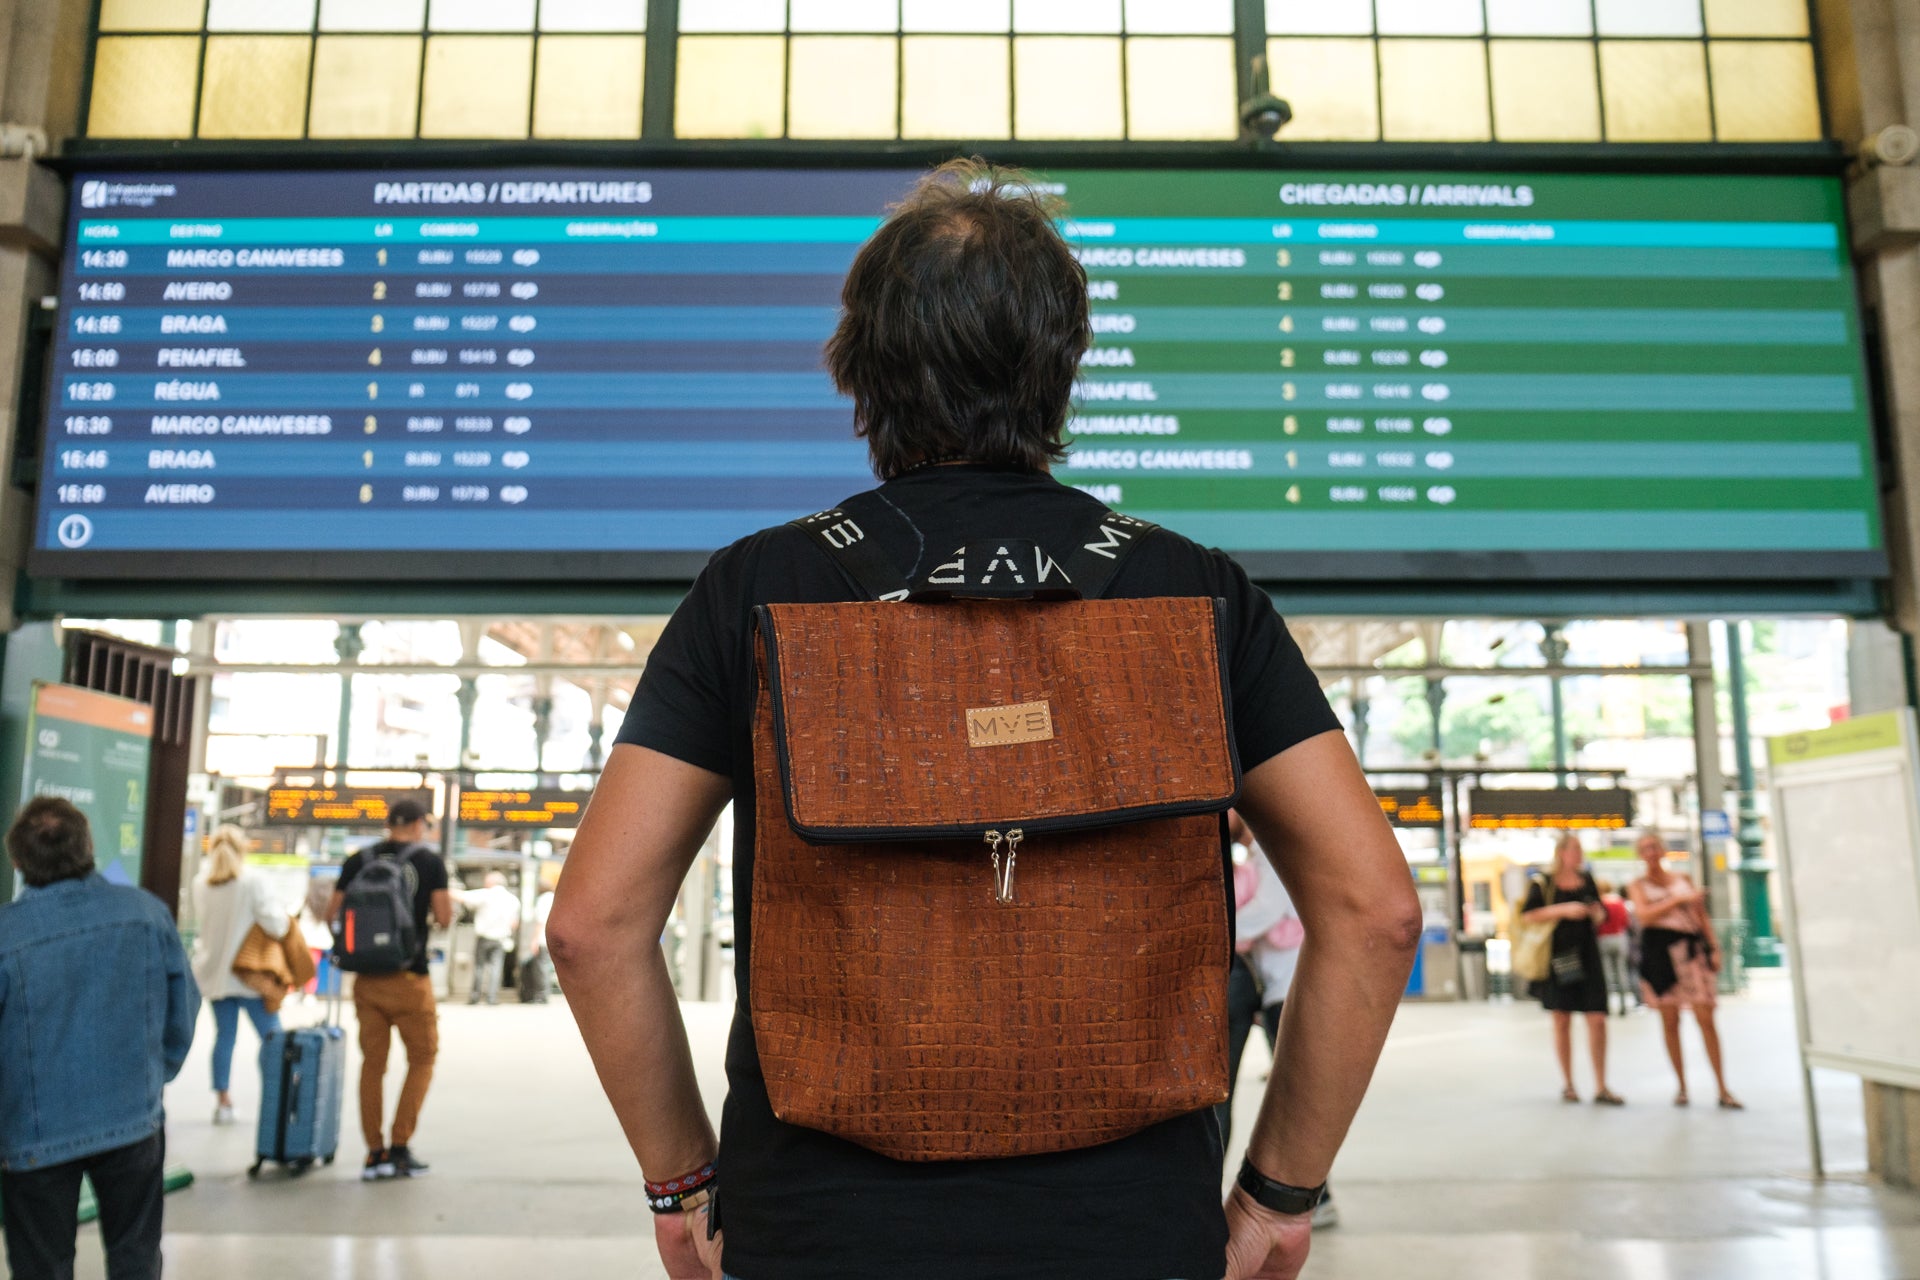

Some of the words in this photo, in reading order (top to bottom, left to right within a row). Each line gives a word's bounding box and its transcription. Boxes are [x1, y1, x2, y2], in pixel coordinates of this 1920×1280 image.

[374, 183, 485, 203] PARTIDAS
[488, 184, 499, 201] /
[501, 182, 652, 203] DEPARTURES
[1280, 184, 1406, 204] CHEGADAS
[1409, 185, 1419, 203] /
[1422, 185, 1532, 206] ARRIVALS
[82, 249, 129, 268] 14:30
[166, 248, 234, 268] MARCO
[235, 249, 344, 268] CANAVESES
[376, 249, 388, 266] 1
[1134, 248, 1246, 268] CANAVESES
[163, 281, 232, 301] AVEIRO
[372, 281, 387, 300] 2
[160, 315, 227, 334] BRAGA
[371, 314, 384, 333] 3
[1090, 314, 1136, 334] EIRO
[157, 348, 245, 367] PENAFIEL
[367, 348, 382, 366] 4
[1078, 347, 1136, 367] RAGA
[154, 378, 220, 401] RÉGUA
[367, 382, 378, 400] 1
[151, 415, 221, 435] MARCO
[221, 415, 332, 435] CANAVESES
[364, 415, 377, 434] 3
[1066, 413, 1180, 435] GUIMARÃES
[148, 449, 216, 469] BRAGA
[362, 450, 374, 468] 1
[1067, 450, 1138, 470] MARCO
[1139, 450, 1253, 470] CANAVESES
[144, 484, 215, 504] AVEIRO
[972, 711, 1046, 739] MVB
